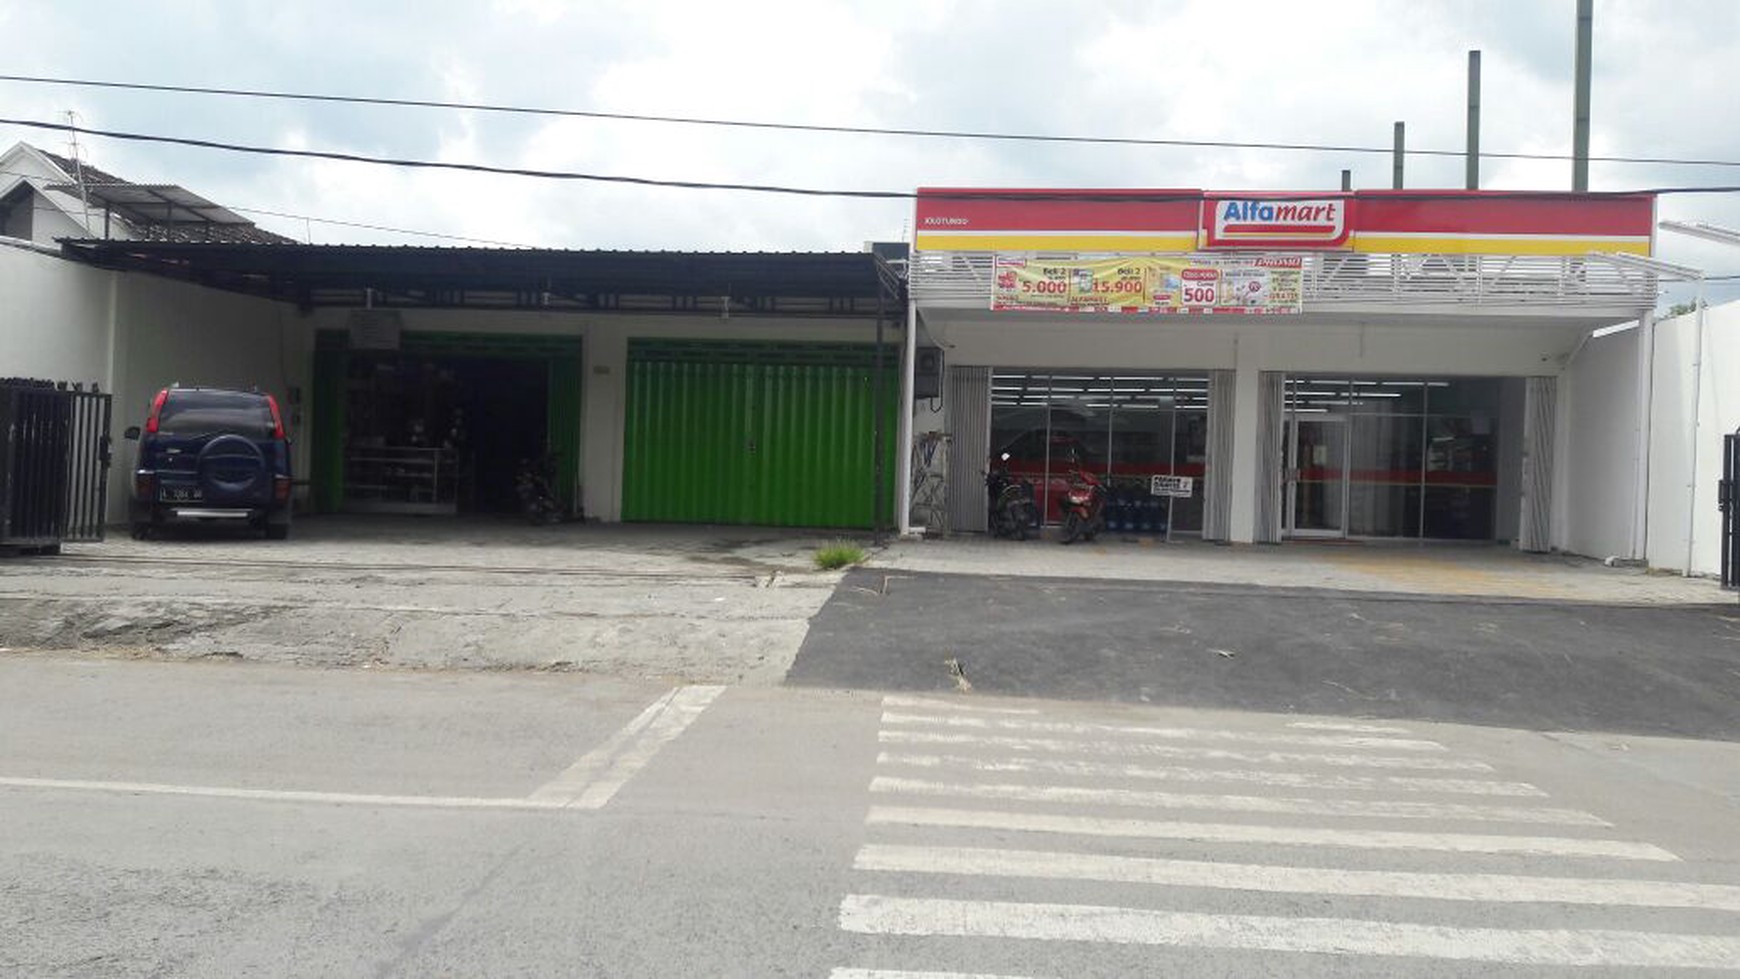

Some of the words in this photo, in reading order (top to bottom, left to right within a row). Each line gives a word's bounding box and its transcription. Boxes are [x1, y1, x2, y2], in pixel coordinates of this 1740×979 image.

[1223, 201, 1336, 221] Alfamart
[1022, 280, 1067, 294] 5.000
[1093, 280, 1143, 293] 15.900
[1184, 288, 1215, 303] 500
